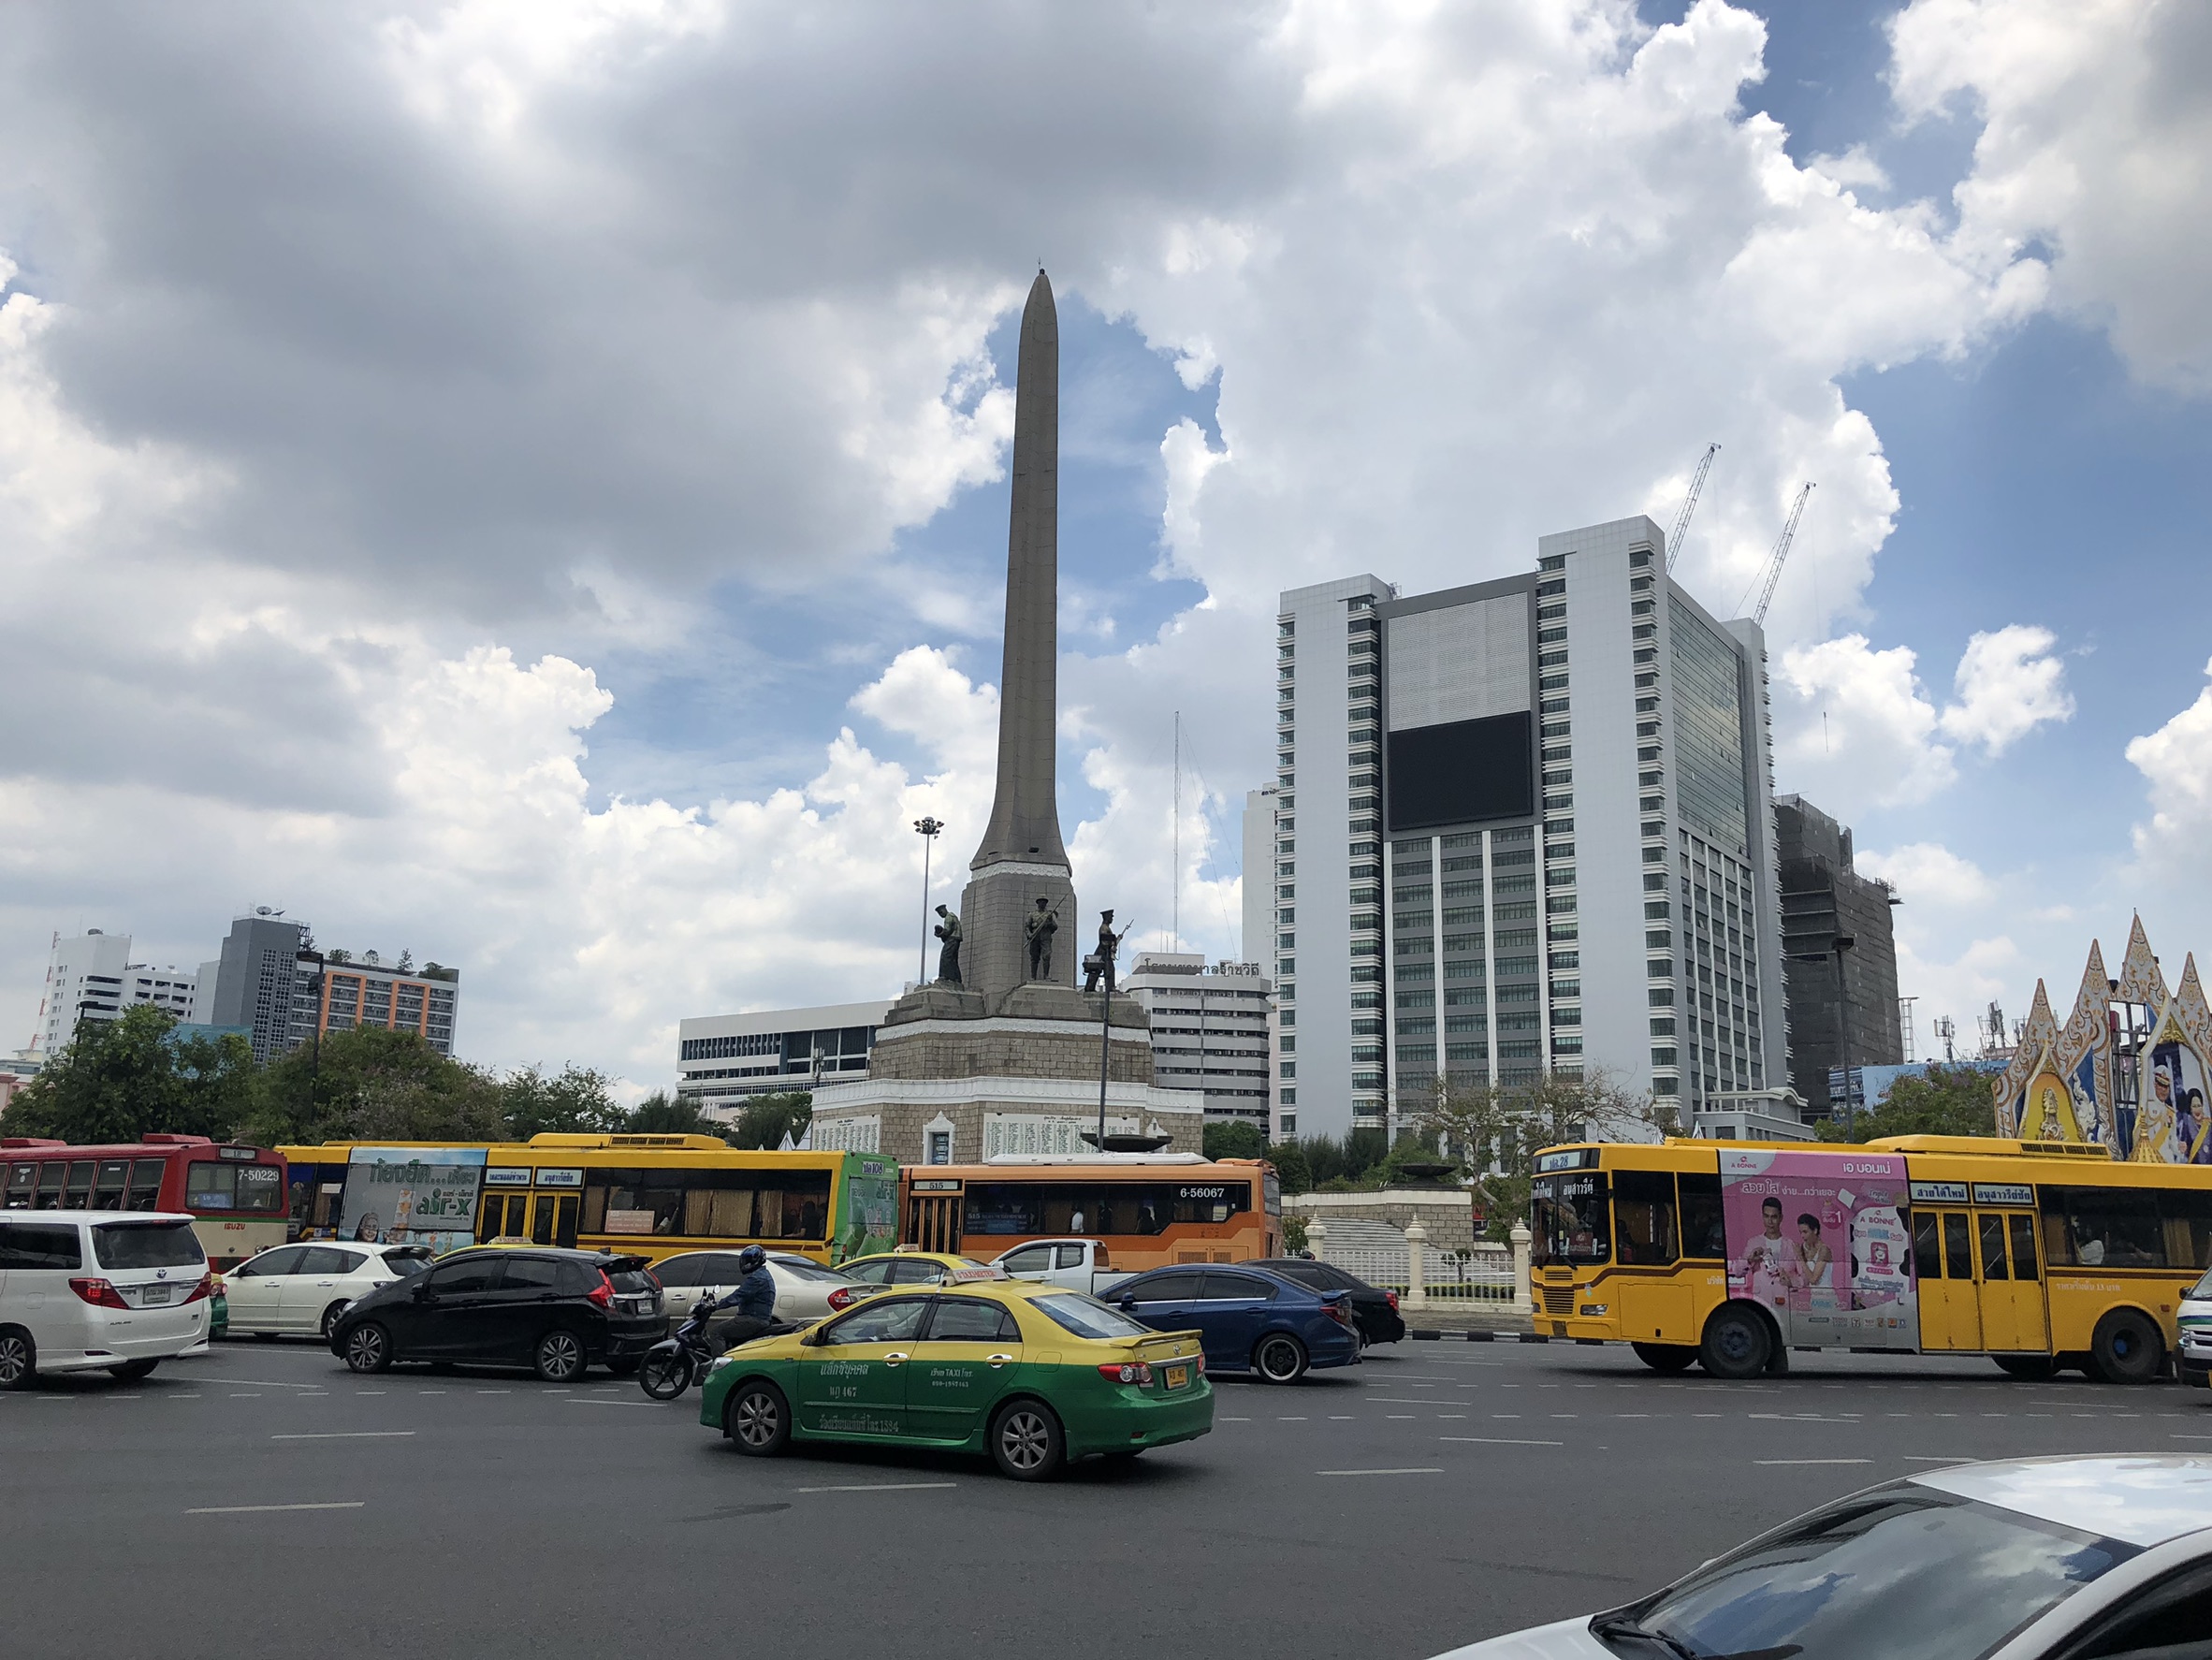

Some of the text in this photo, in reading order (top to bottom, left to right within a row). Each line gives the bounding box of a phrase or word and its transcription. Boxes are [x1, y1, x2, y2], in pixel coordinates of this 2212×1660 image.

[1144, 957, 1259, 978] โาลราชวิถี
[1842, 1160, 1891, 1174] เอ บอนเน่
[238, 1169, 279, 1182] 7-50229
[929, 1182, 944, 1190] 515
[1180, 1187, 1225, 1198] 6-56067
[1741, 1182, 1765, 1194] สวย
[1765, 1178, 1779, 1194] ใส
[1916, 1186, 1964, 1198] สายใต้ใหม่
[415, 1187, 473, 1216] air-x
[1977, 1188, 2030, 1202] อนุสาวรีย์ชัย
[945, 1368, 961, 1377] TAXI
[842, 1386, 857, 1397] 467
